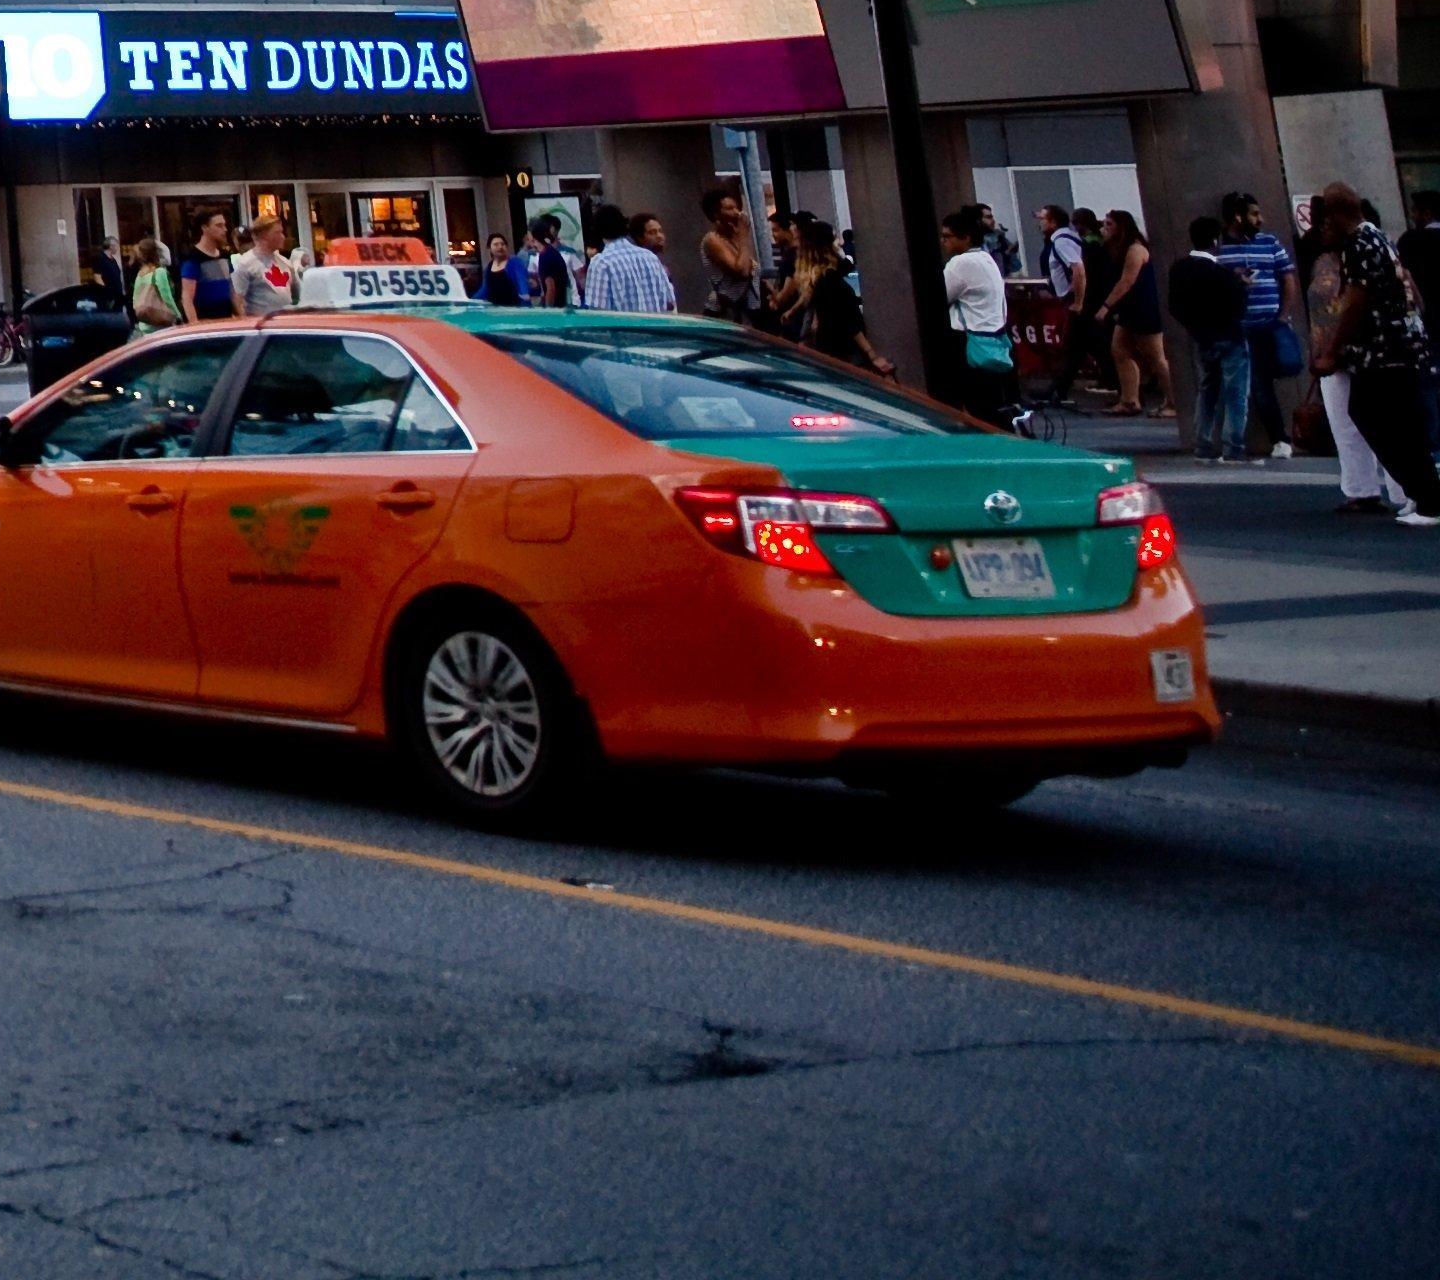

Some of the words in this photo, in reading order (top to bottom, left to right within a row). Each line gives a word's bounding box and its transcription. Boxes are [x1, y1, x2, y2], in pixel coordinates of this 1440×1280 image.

[119, 40, 248, 91] TEN
[266, 40, 469, 91] DUNDAS
[357, 243, 411, 261] BECK
